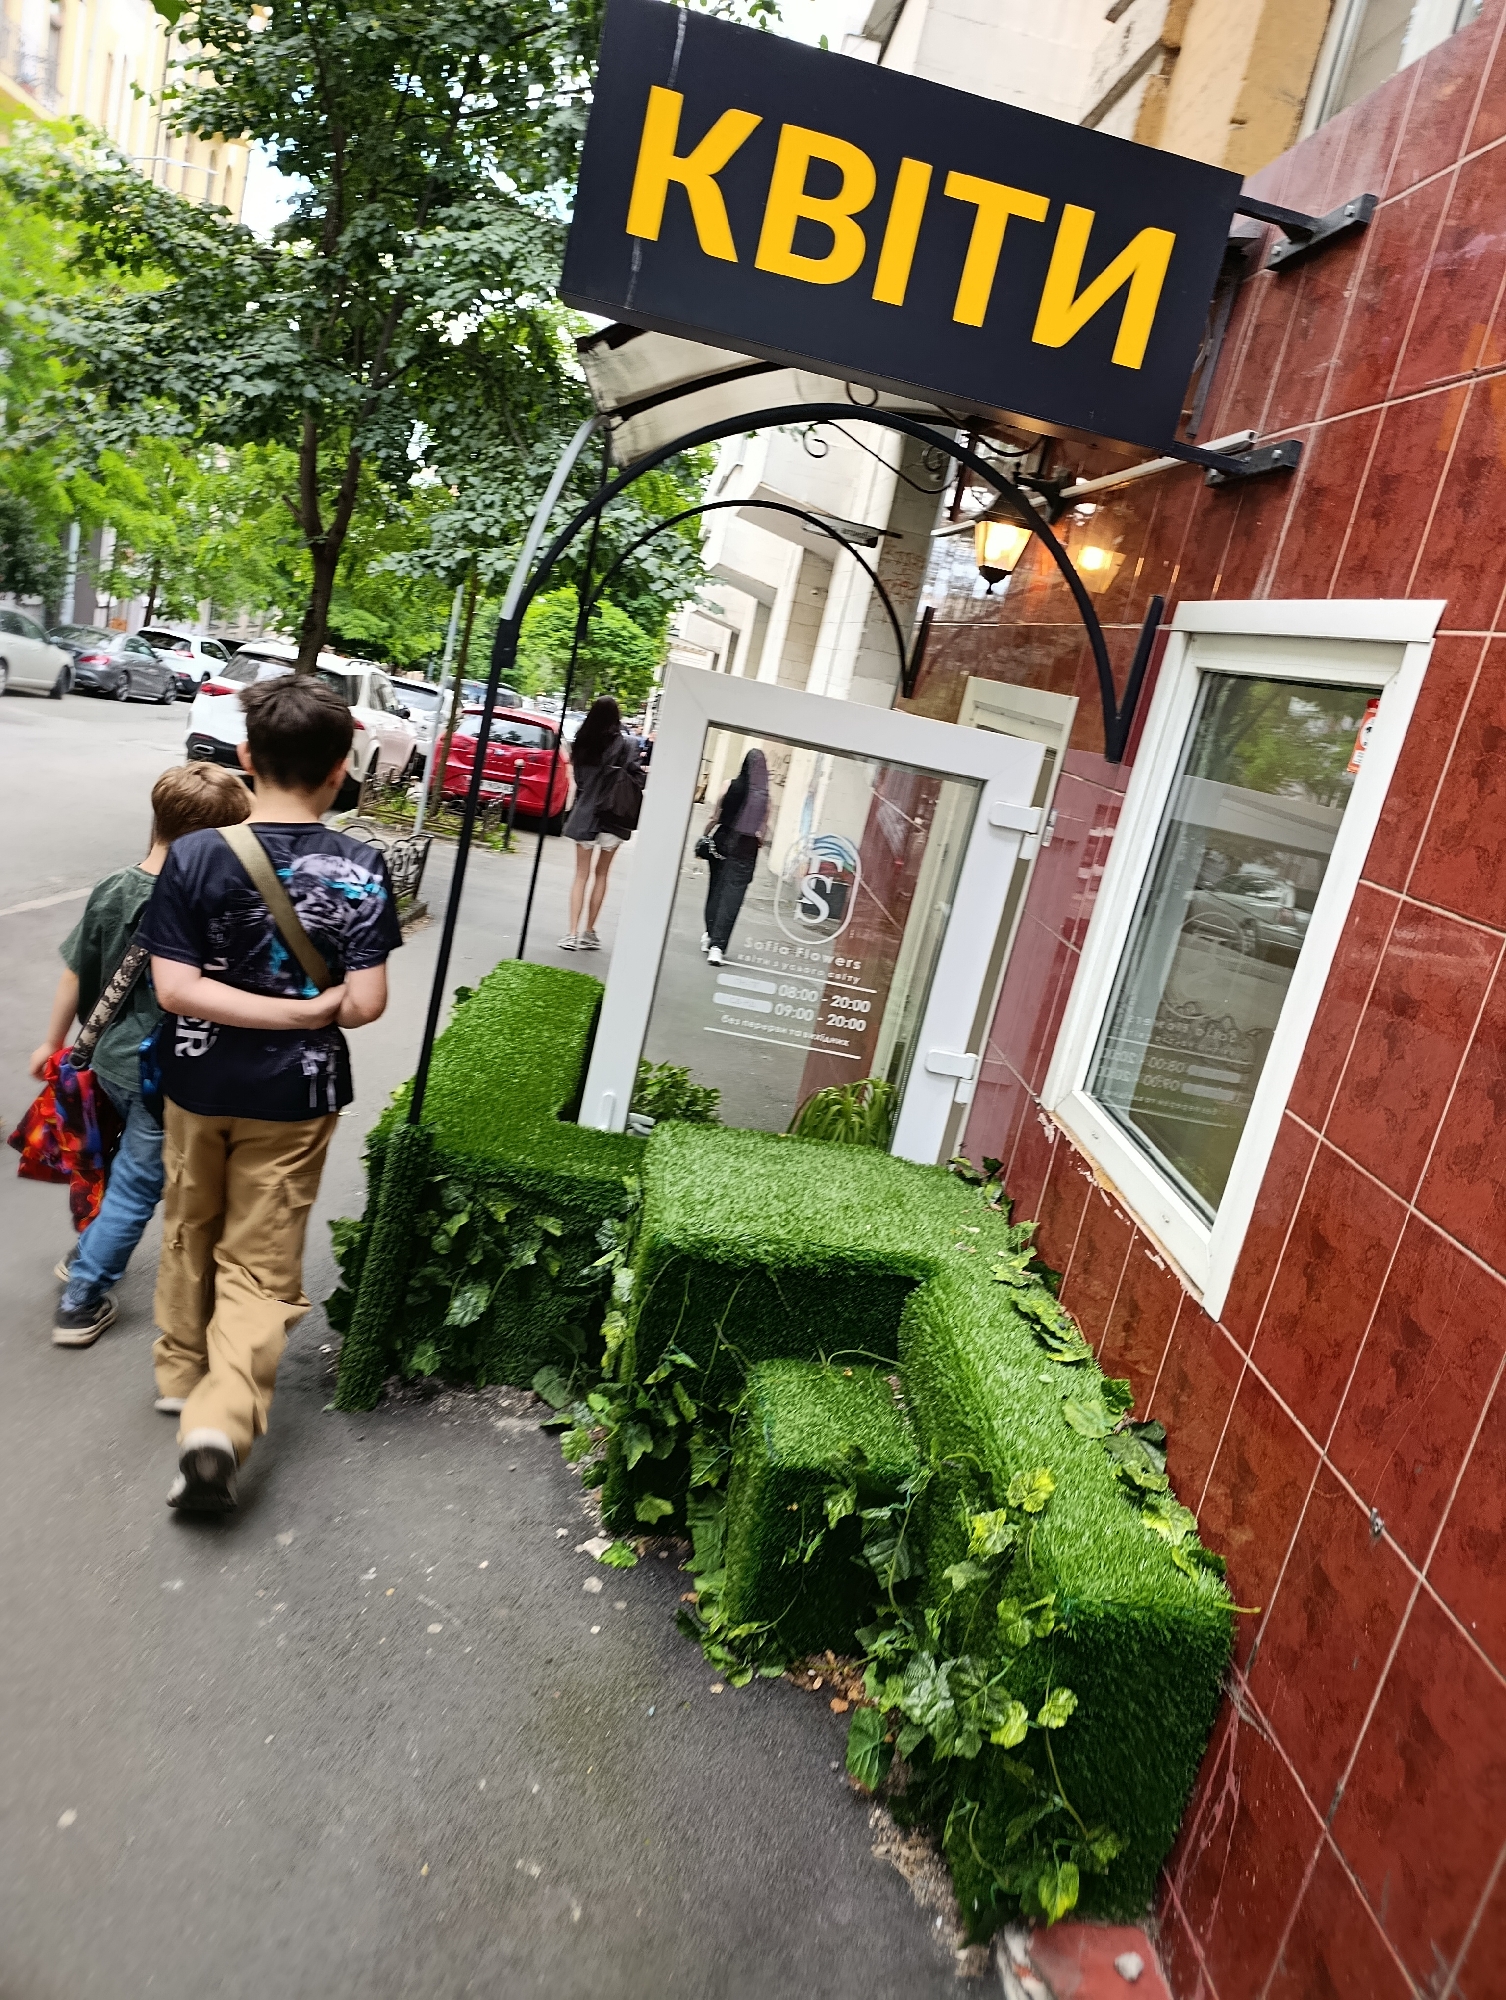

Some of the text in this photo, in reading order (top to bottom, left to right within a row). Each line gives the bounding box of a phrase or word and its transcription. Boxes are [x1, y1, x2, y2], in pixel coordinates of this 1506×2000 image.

[626, 85, 1176, 370] КВІТИ
[743, 936, 862, 970] Sofia Flowers
[778, 984, 819, 1002] 08:00
[829, 994, 872, 1013] 20:00
[774, 1003, 815, 1021] 09:00
[826, 1013, 867, 1032] 20:00
